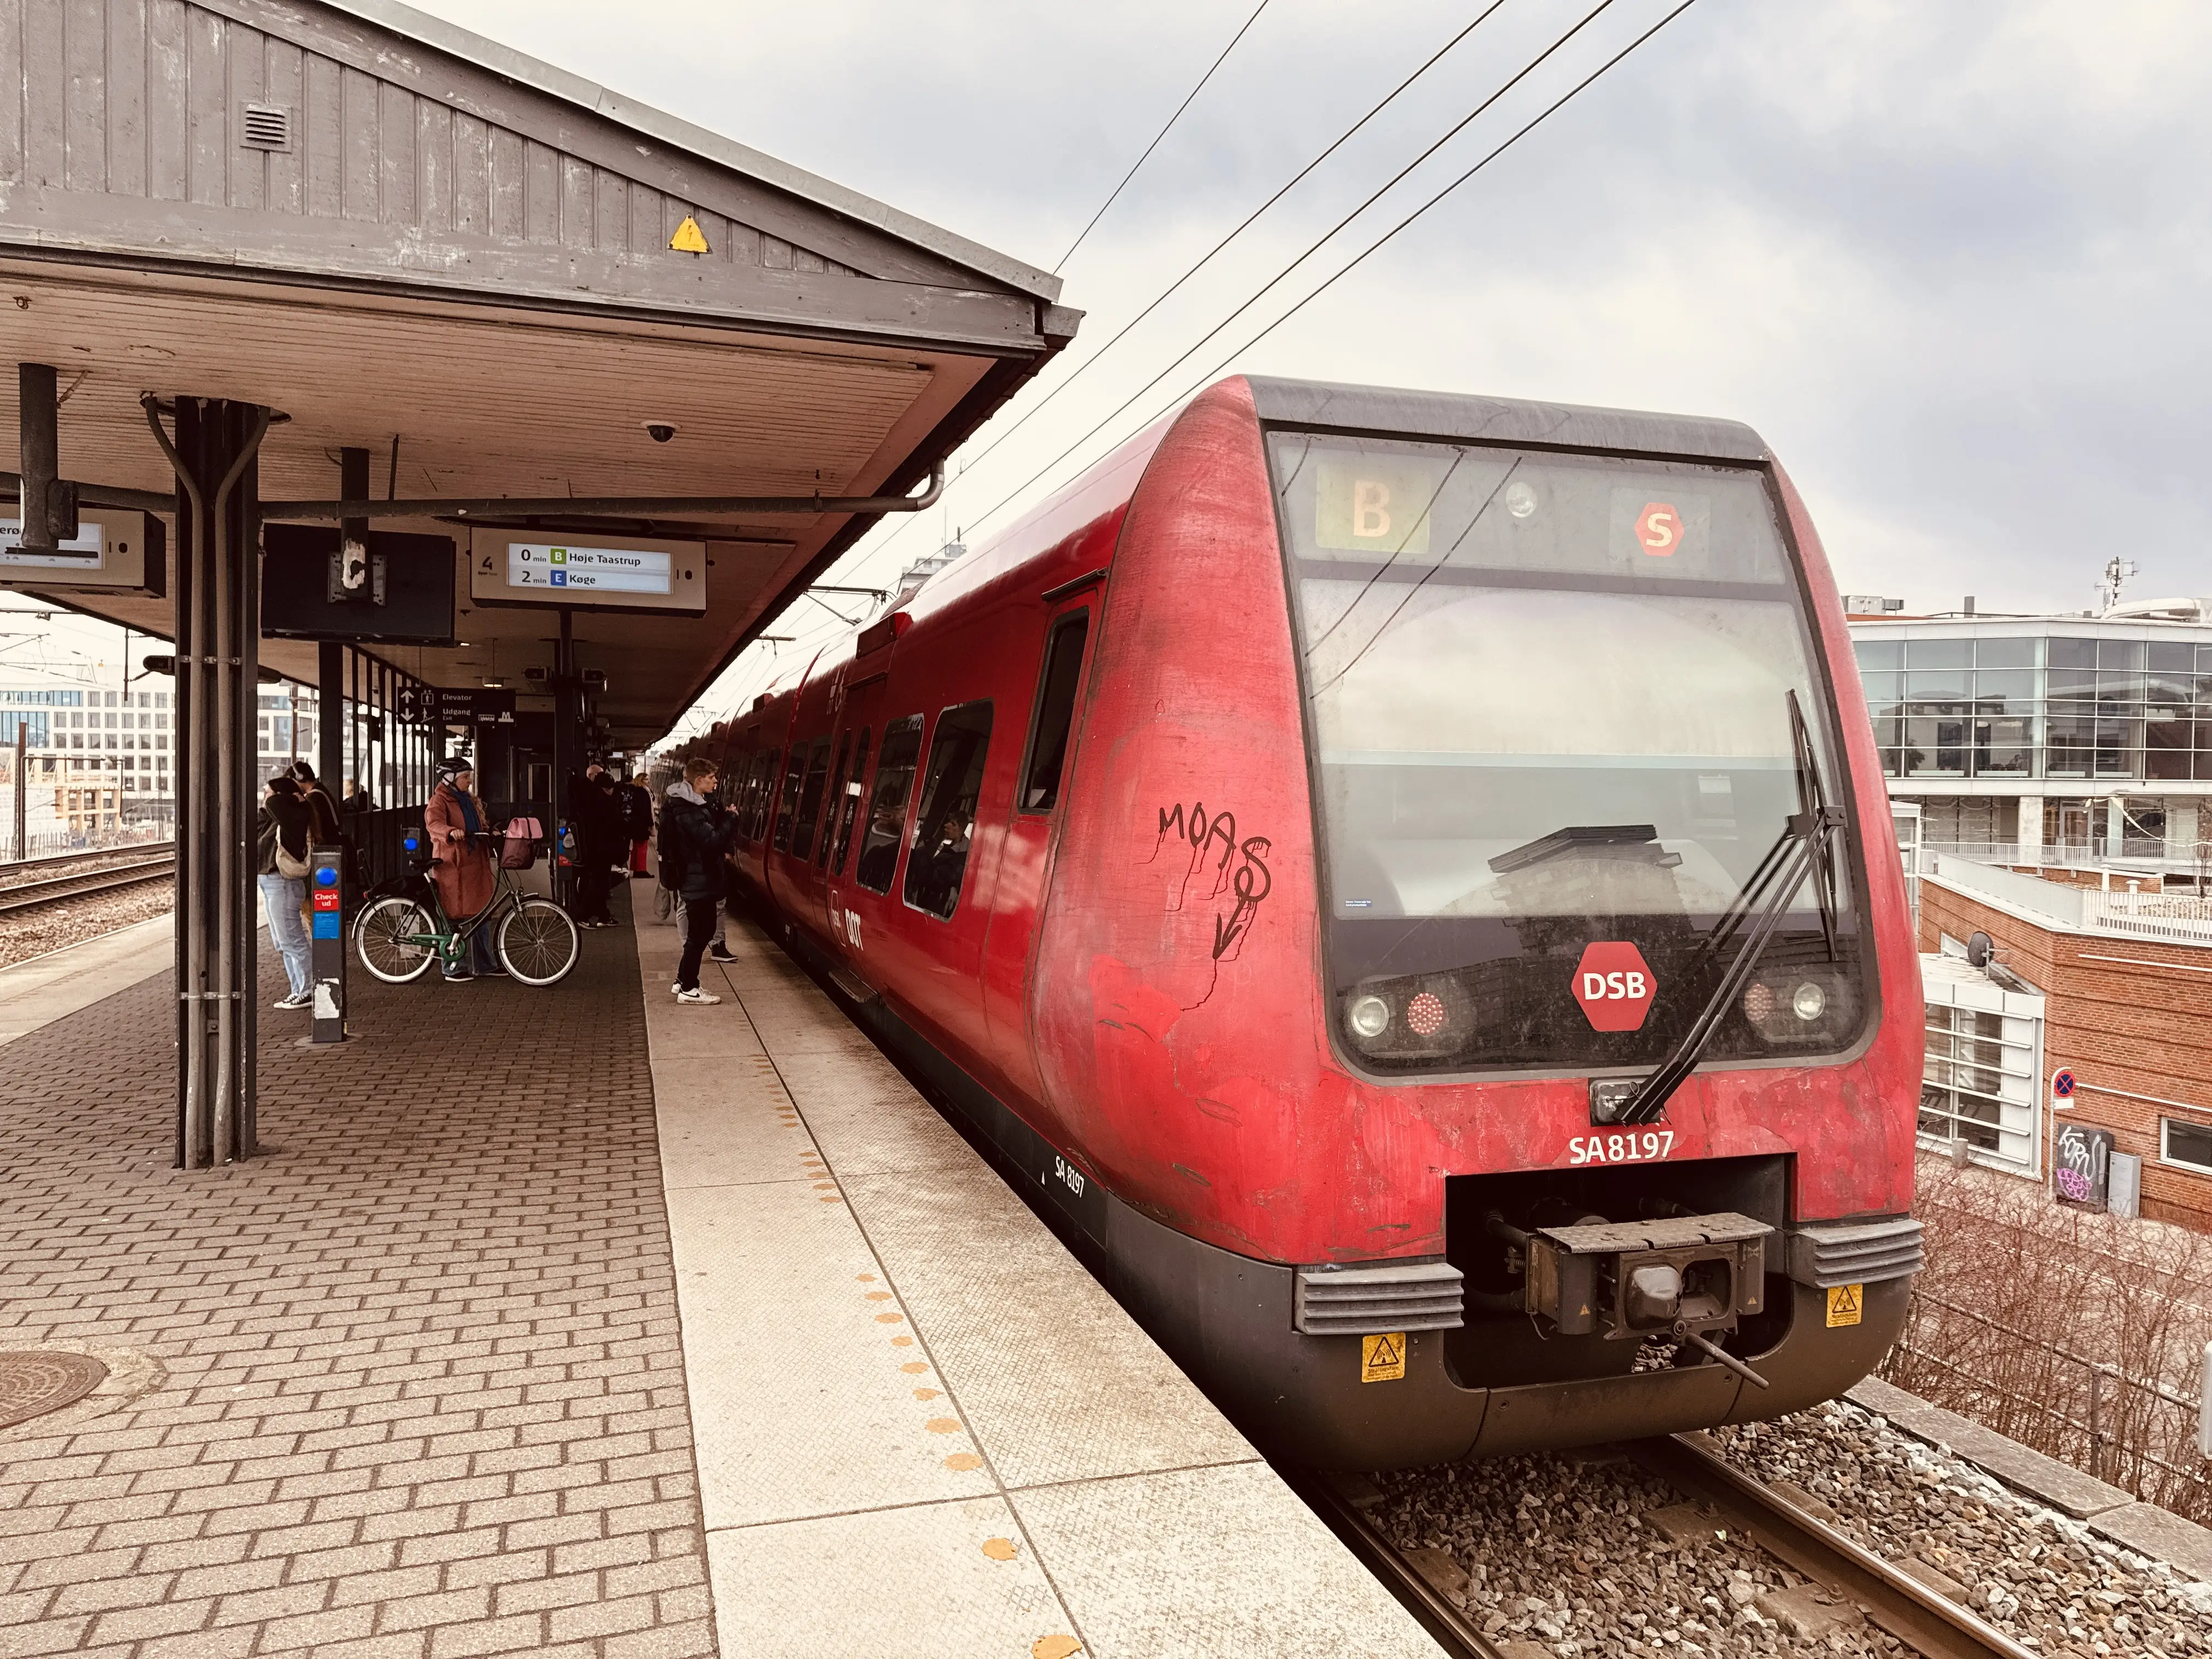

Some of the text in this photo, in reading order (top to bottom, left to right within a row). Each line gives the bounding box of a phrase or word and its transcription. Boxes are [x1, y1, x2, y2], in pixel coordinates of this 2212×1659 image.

[1353, 479, 1391, 537] B
[1646, 513, 1672, 547] S
[482, 556, 493, 570] 4
[521, 549, 531, 561] 0
[555, 552, 562, 561] B
[569, 553, 594, 563] Høje
[597, 555, 641, 567] Taastrup
[522, 571, 531, 583] 2
[555, 573, 562, 583] E
[569, 574, 596, 585] Køge
[1159, 802, 1272, 960] MOAS
[1583, 972, 1646, 1000] DSB
[1569, 1130, 1675, 1165] SA8197
[1055, 1155, 1085, 1198] SA 8197
